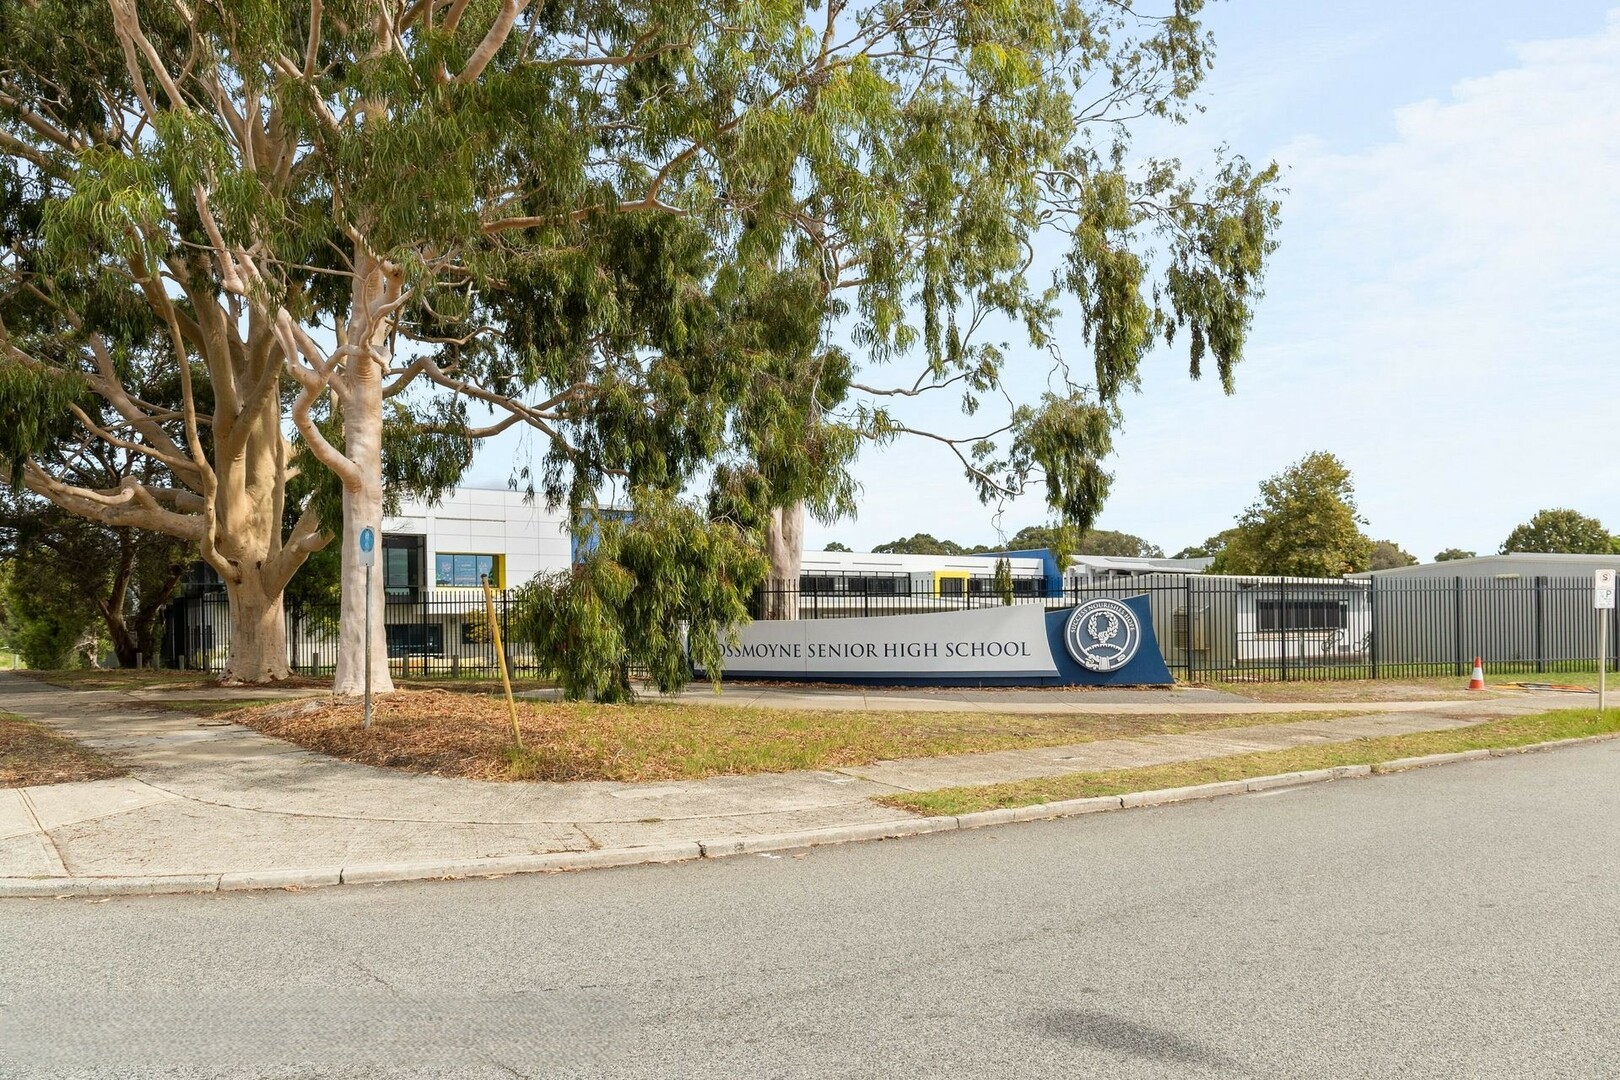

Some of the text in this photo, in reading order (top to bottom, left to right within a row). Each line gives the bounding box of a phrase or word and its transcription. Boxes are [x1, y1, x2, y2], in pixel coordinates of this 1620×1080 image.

[1070, 602, 1135, 633] SUCCESS NOURISHES HOPE
[715, 641, 1031, 658] OSSMOYNE SENIOR HIGH SCHOOL
